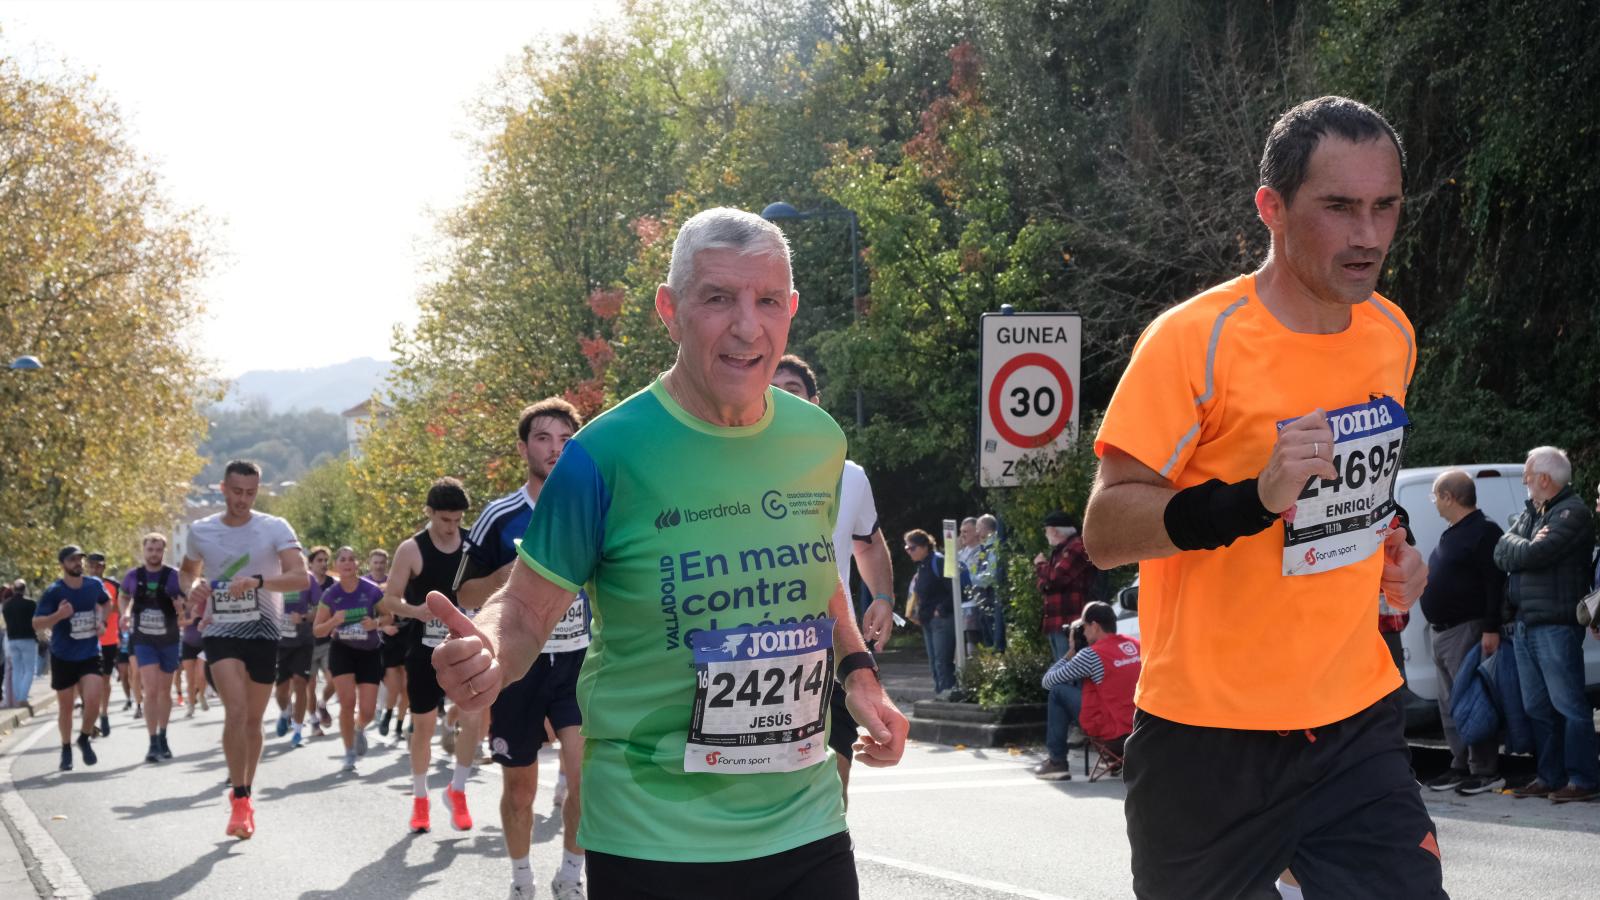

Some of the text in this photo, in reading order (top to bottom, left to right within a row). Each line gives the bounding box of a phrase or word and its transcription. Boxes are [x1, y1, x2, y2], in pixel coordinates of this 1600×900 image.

[997, 327, 1067, 344] GUNEA
[1010, 386, 1055, 417] 30
[685, 501, 751, 523] Iberdrola
[680, 534, 836, 582] En march
[1338, 544, 1358, 556] sport
[660, 555, 680, 651] VALLADOLID
[682, 577, 807, 617] contra
[746, 626, 819, 658] Joma
[708, 660, 823, 709] 24214
[750, 711, 793, 729] JESÚS
[748, 757, 771, 767] sport
